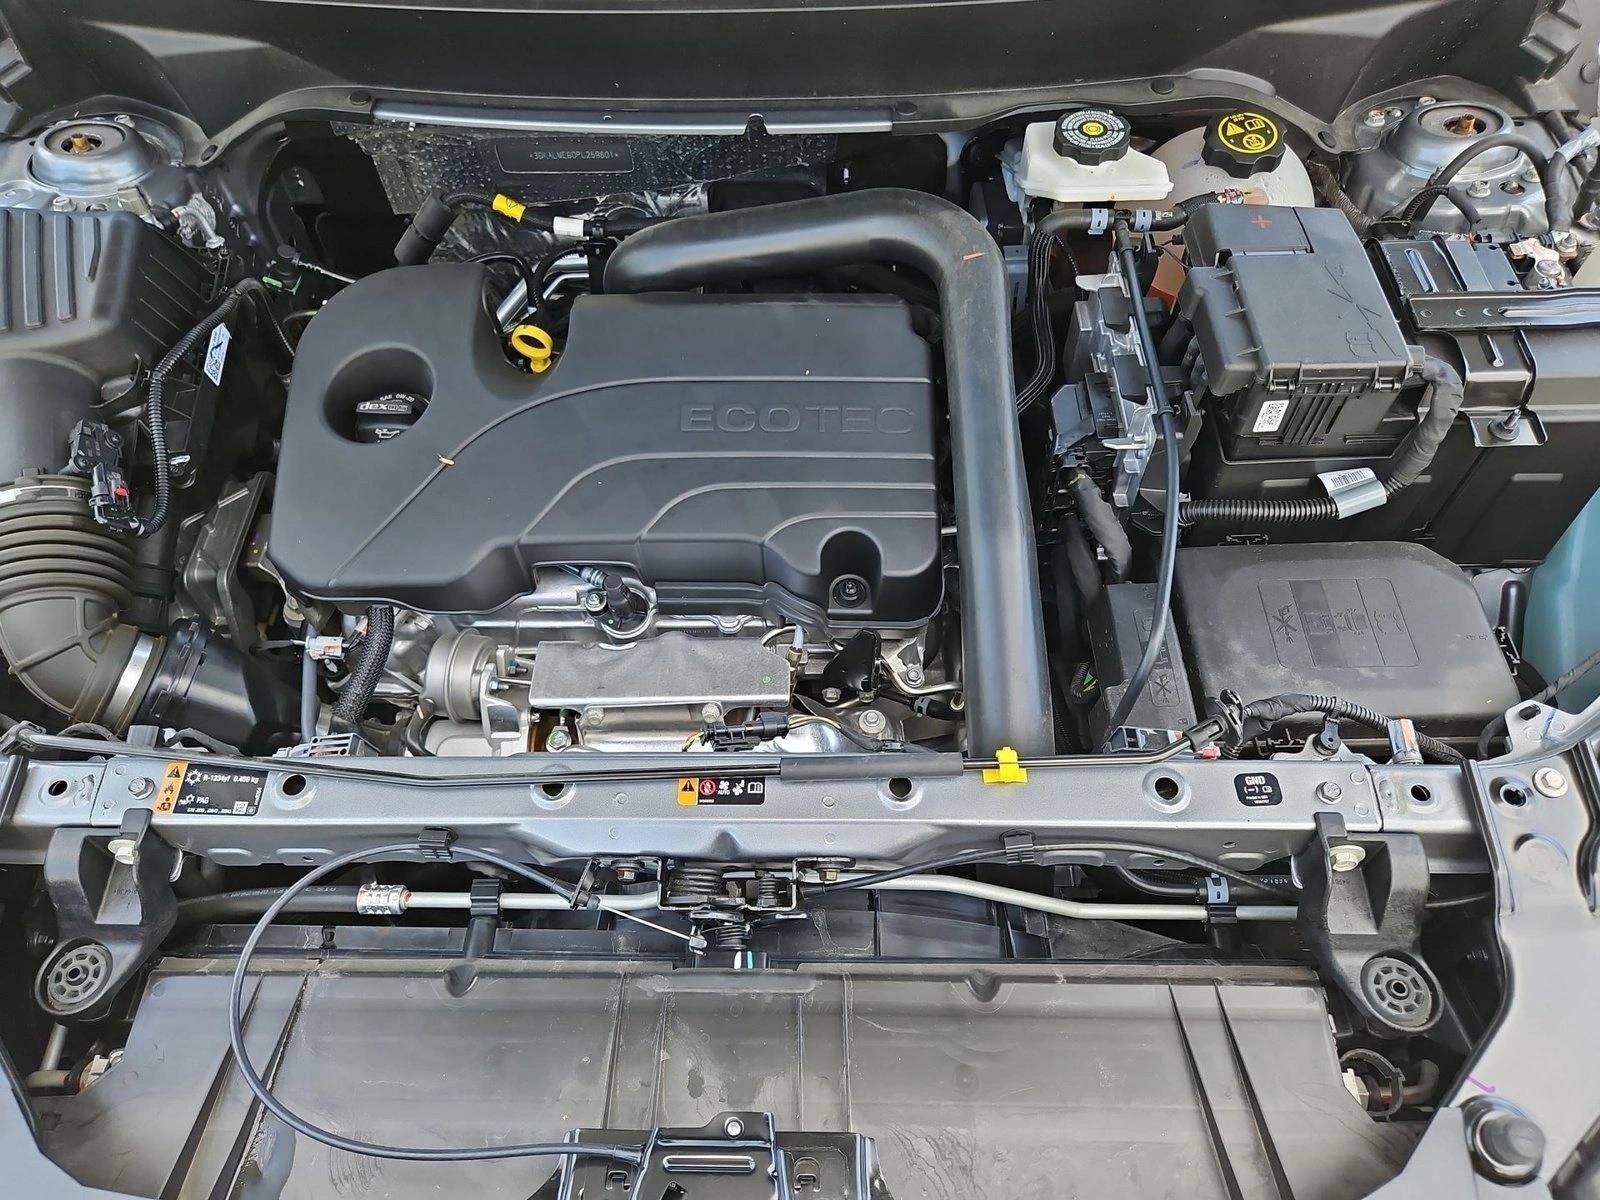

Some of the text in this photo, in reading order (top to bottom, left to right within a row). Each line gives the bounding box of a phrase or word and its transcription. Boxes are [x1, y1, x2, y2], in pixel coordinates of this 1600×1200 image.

[359, 402, 409, 412] dexos
[680, 406, 914, 434] ECOTEC
[250, 776, 260, 785] kg
[1244, 775, 1266, 786] GND
[196, 796, 210, 804] PAG
